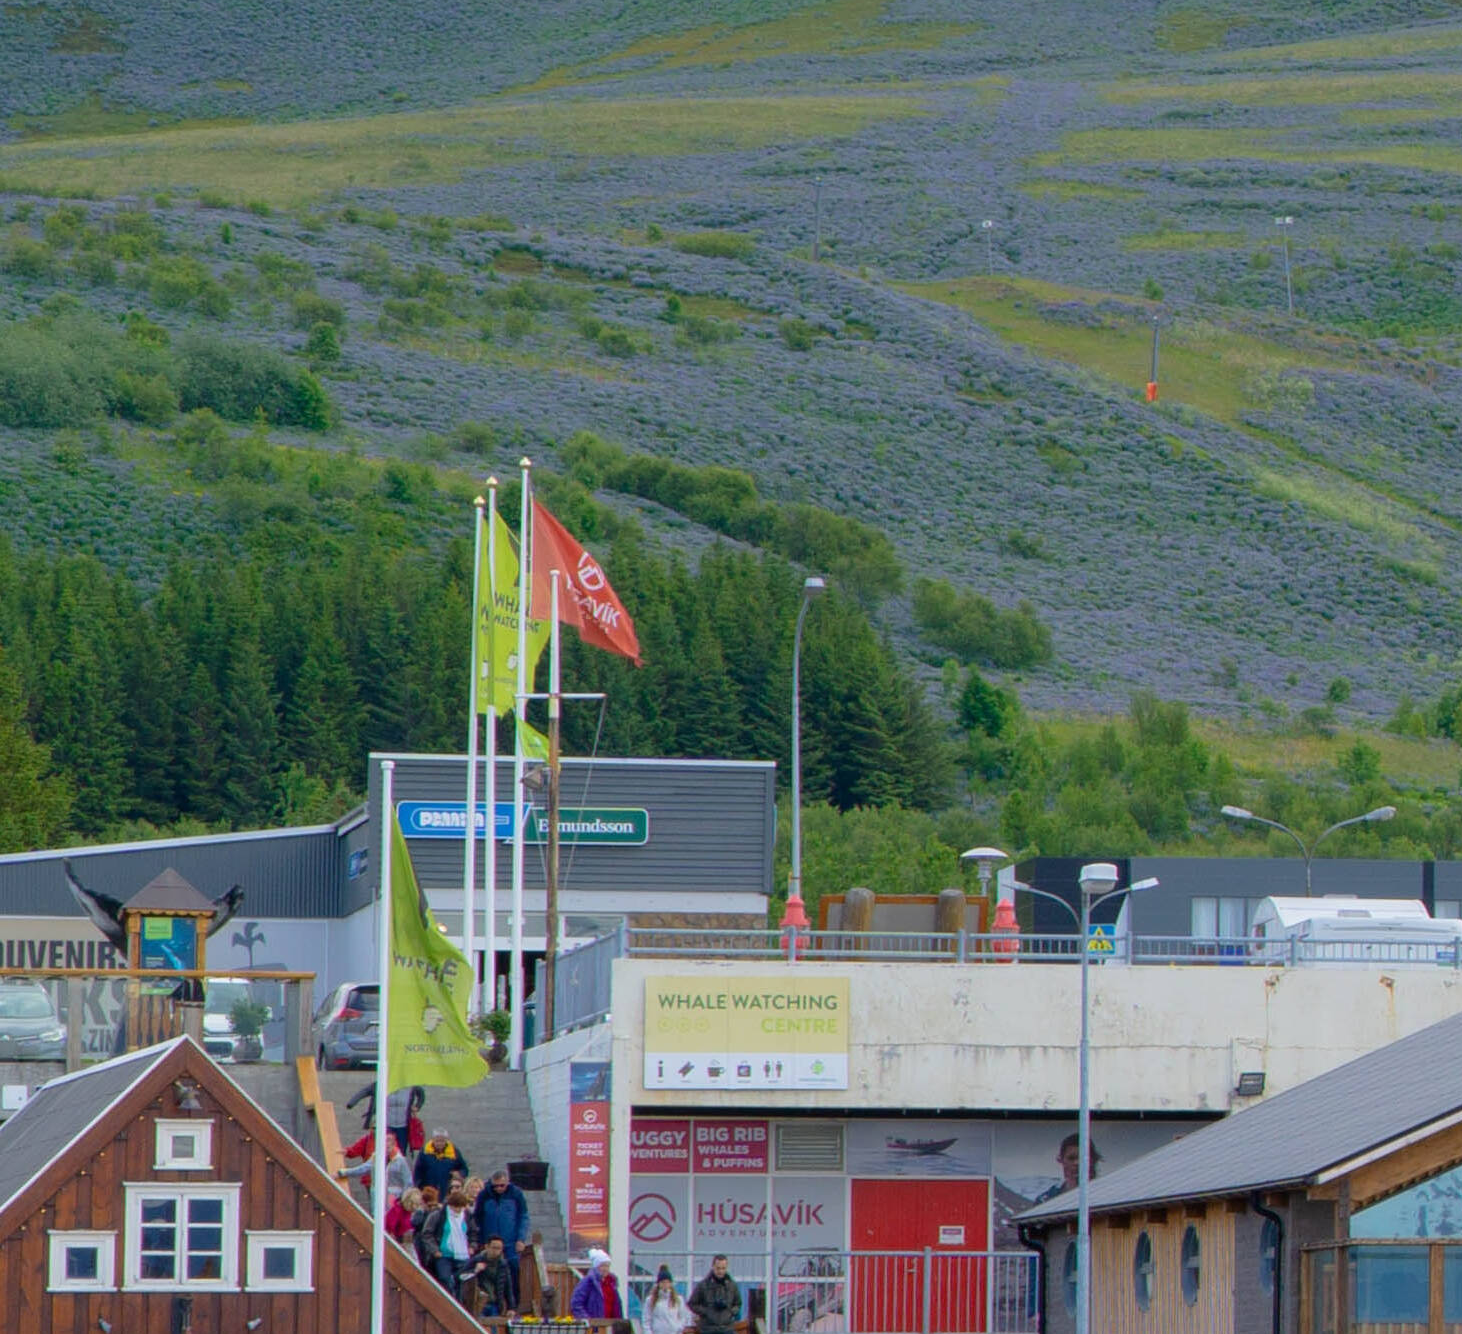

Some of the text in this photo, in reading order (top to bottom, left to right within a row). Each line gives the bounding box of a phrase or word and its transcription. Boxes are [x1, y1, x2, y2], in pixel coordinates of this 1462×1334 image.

[538, 818, 634, 834] Emundsson
[658, 994, 839, 1011] WHALE WATCHING
[761, 1018, 839, 1034] CENTRE
[632, 1130, 686, 1146] UGGY
[696, 1127, 766, 1142] BIG RIB
[631, 1148, 688, 1159] VENTURES
[697, 1145, 750, 1155] WHALES
[702, 1158, 764, 1168] & PUFFINS
[698, 1198, 825, 1226] HÚSAVÍK
